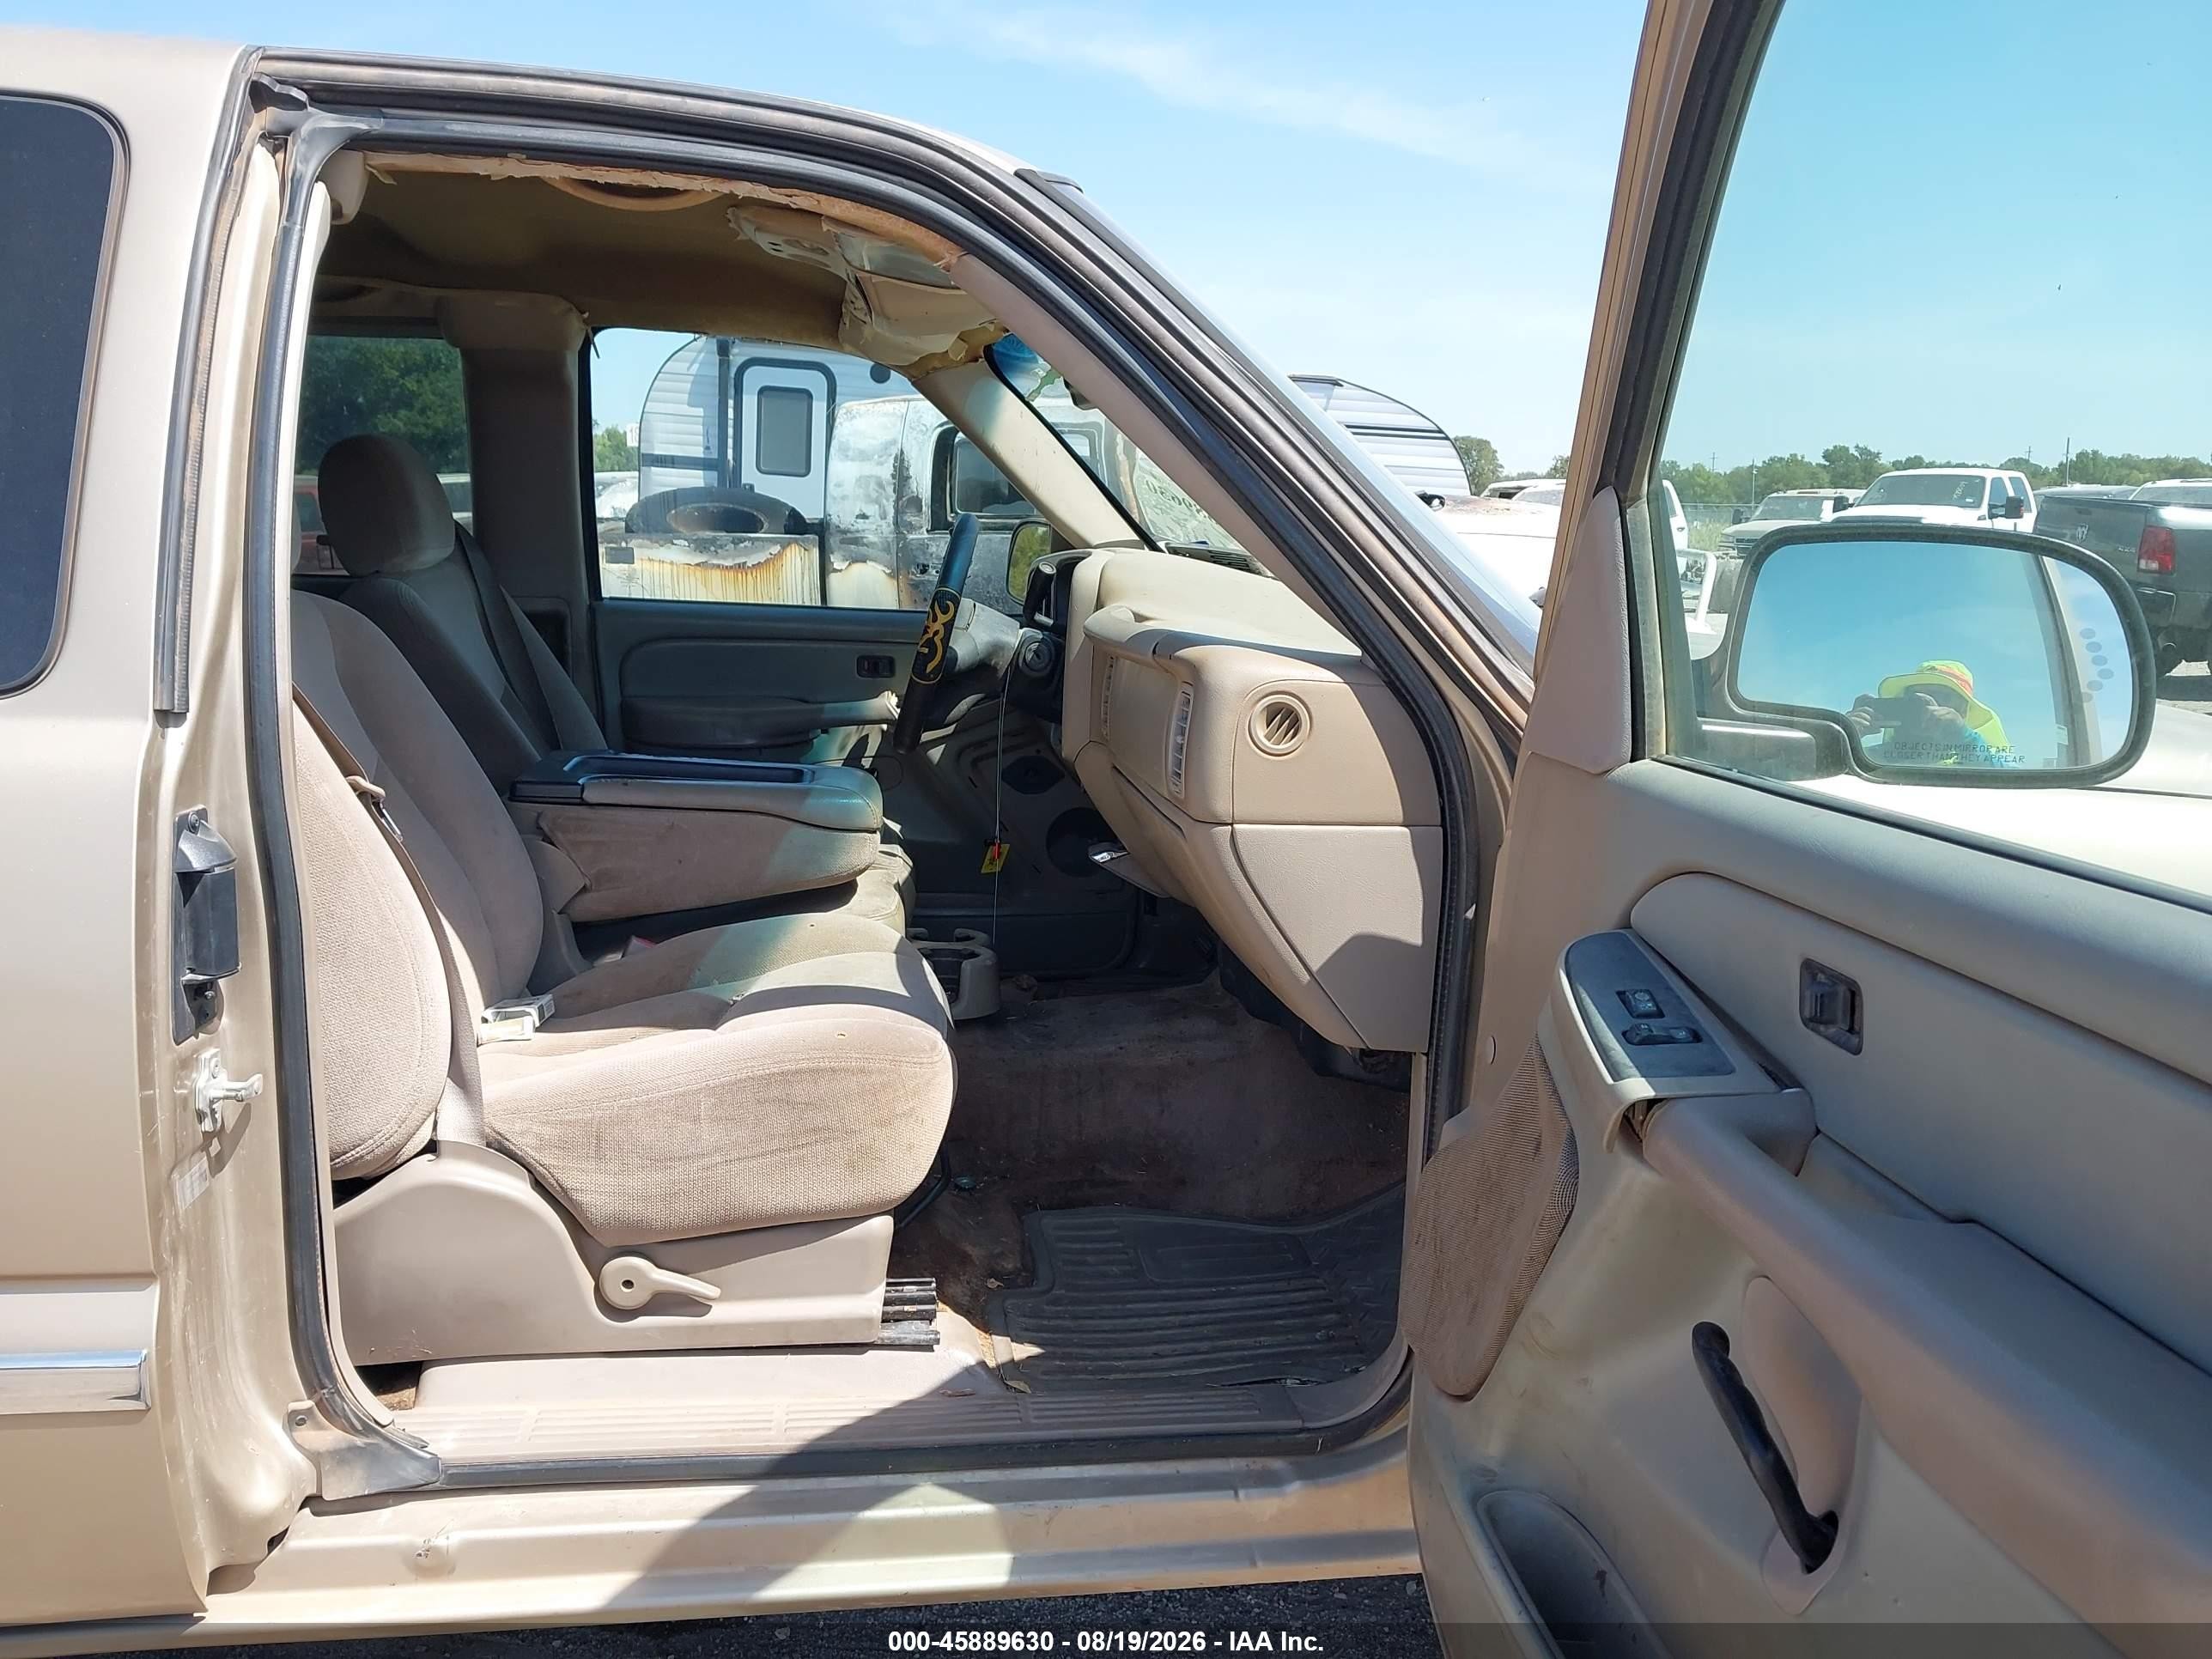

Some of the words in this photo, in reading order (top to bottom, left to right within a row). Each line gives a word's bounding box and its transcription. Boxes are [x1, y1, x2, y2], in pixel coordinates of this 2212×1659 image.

[1894, 741, 1942, 752] OBJECTS
[1954, 744, 1992, 754] MIRROR
[1996, 745, 2015, 755] ARE
[1883, 750, 1923, 760] CLOSER
[1984, 755, 2025, 763] APPEAR
